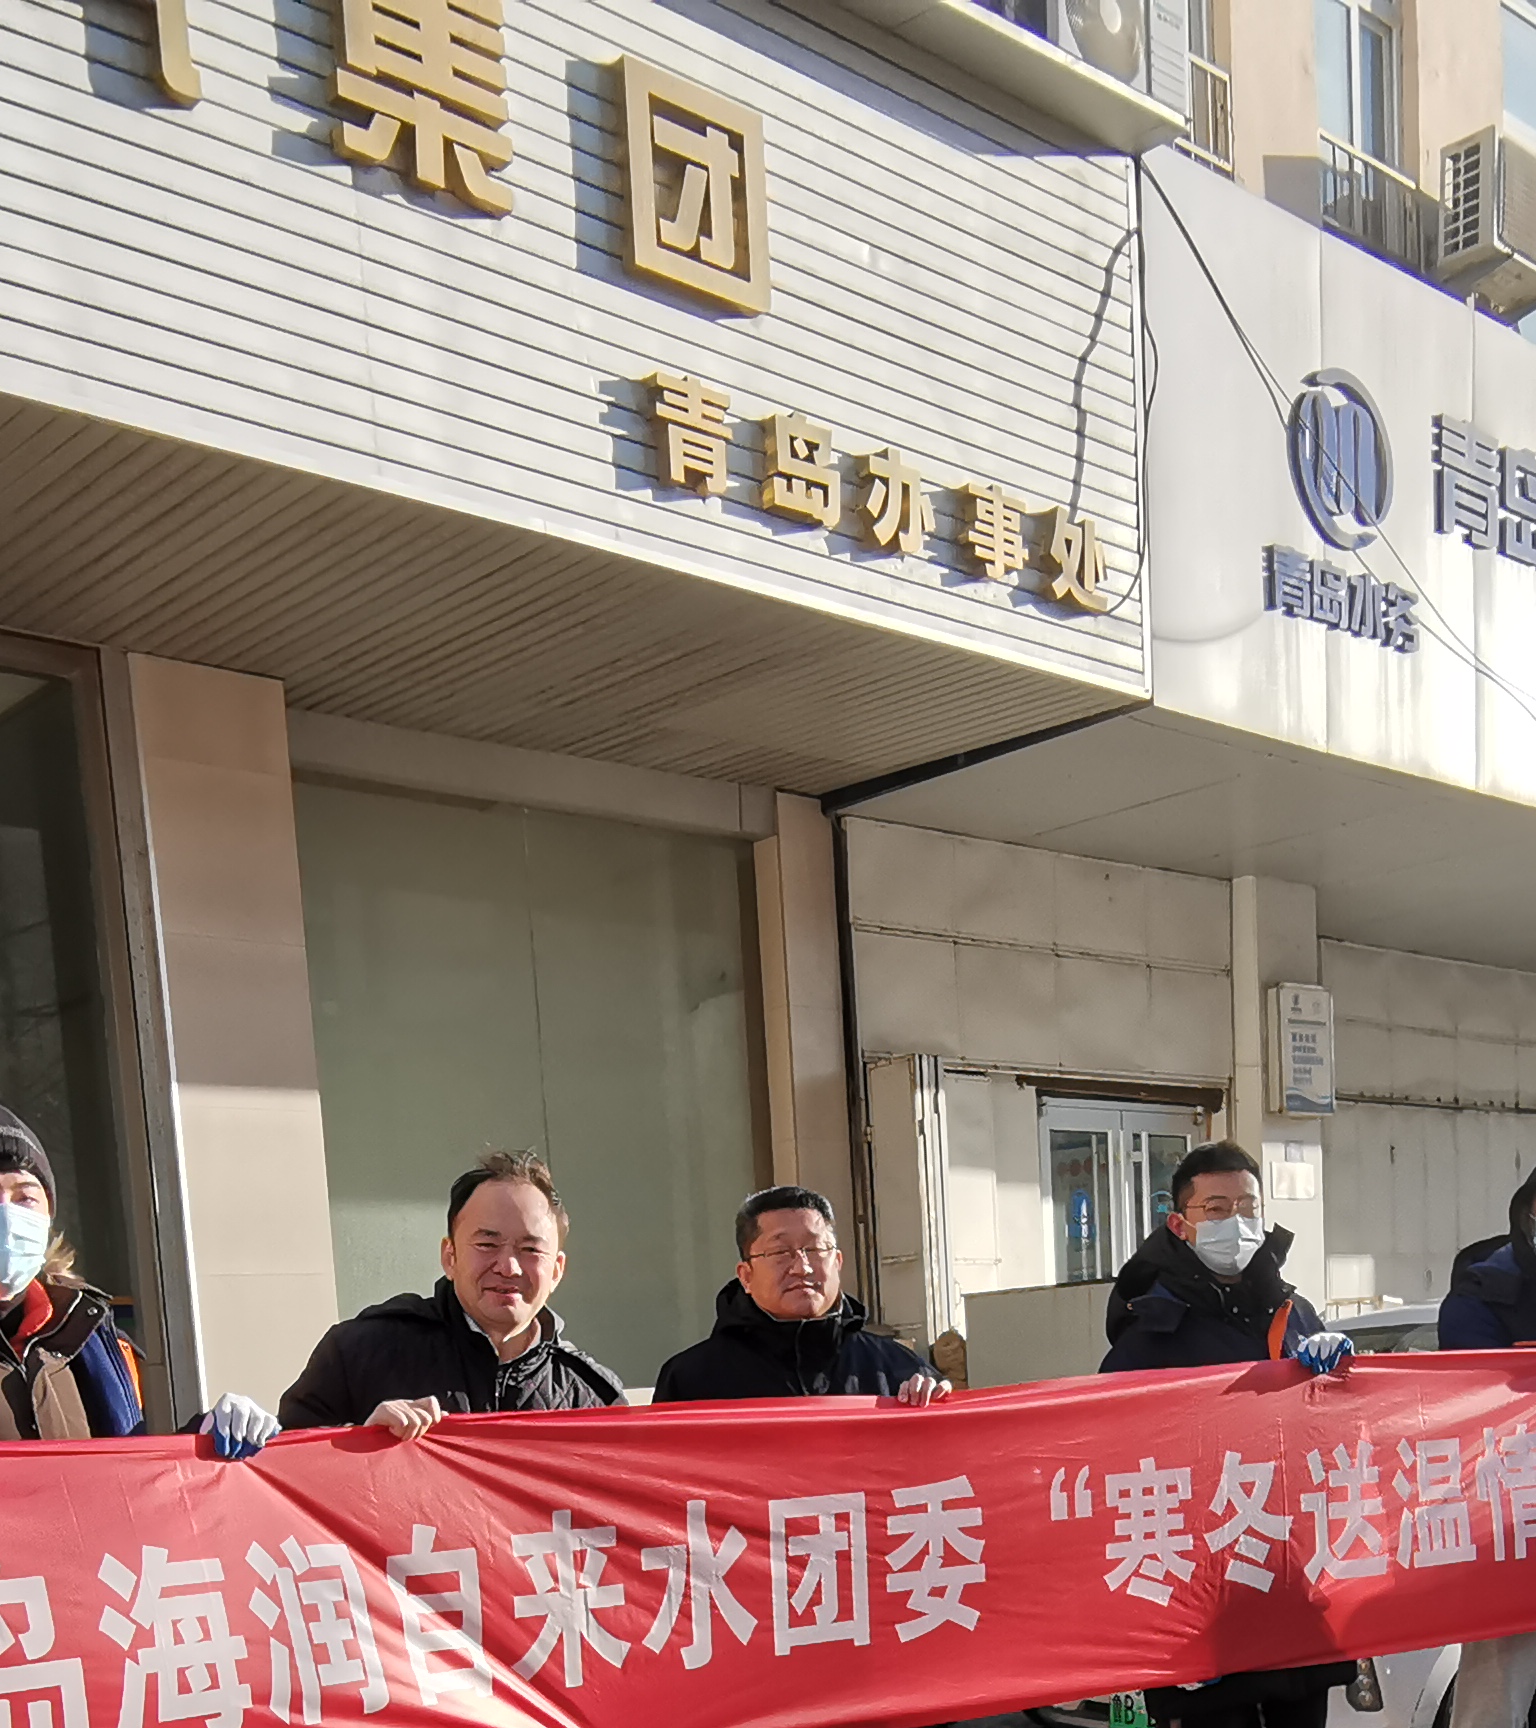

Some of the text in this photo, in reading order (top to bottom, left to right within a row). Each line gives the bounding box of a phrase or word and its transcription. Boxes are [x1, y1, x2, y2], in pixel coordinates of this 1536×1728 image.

[644, 370, 1109, 613] 青岛办事处
[1261, 543, 1420, 654] 青岛水务
